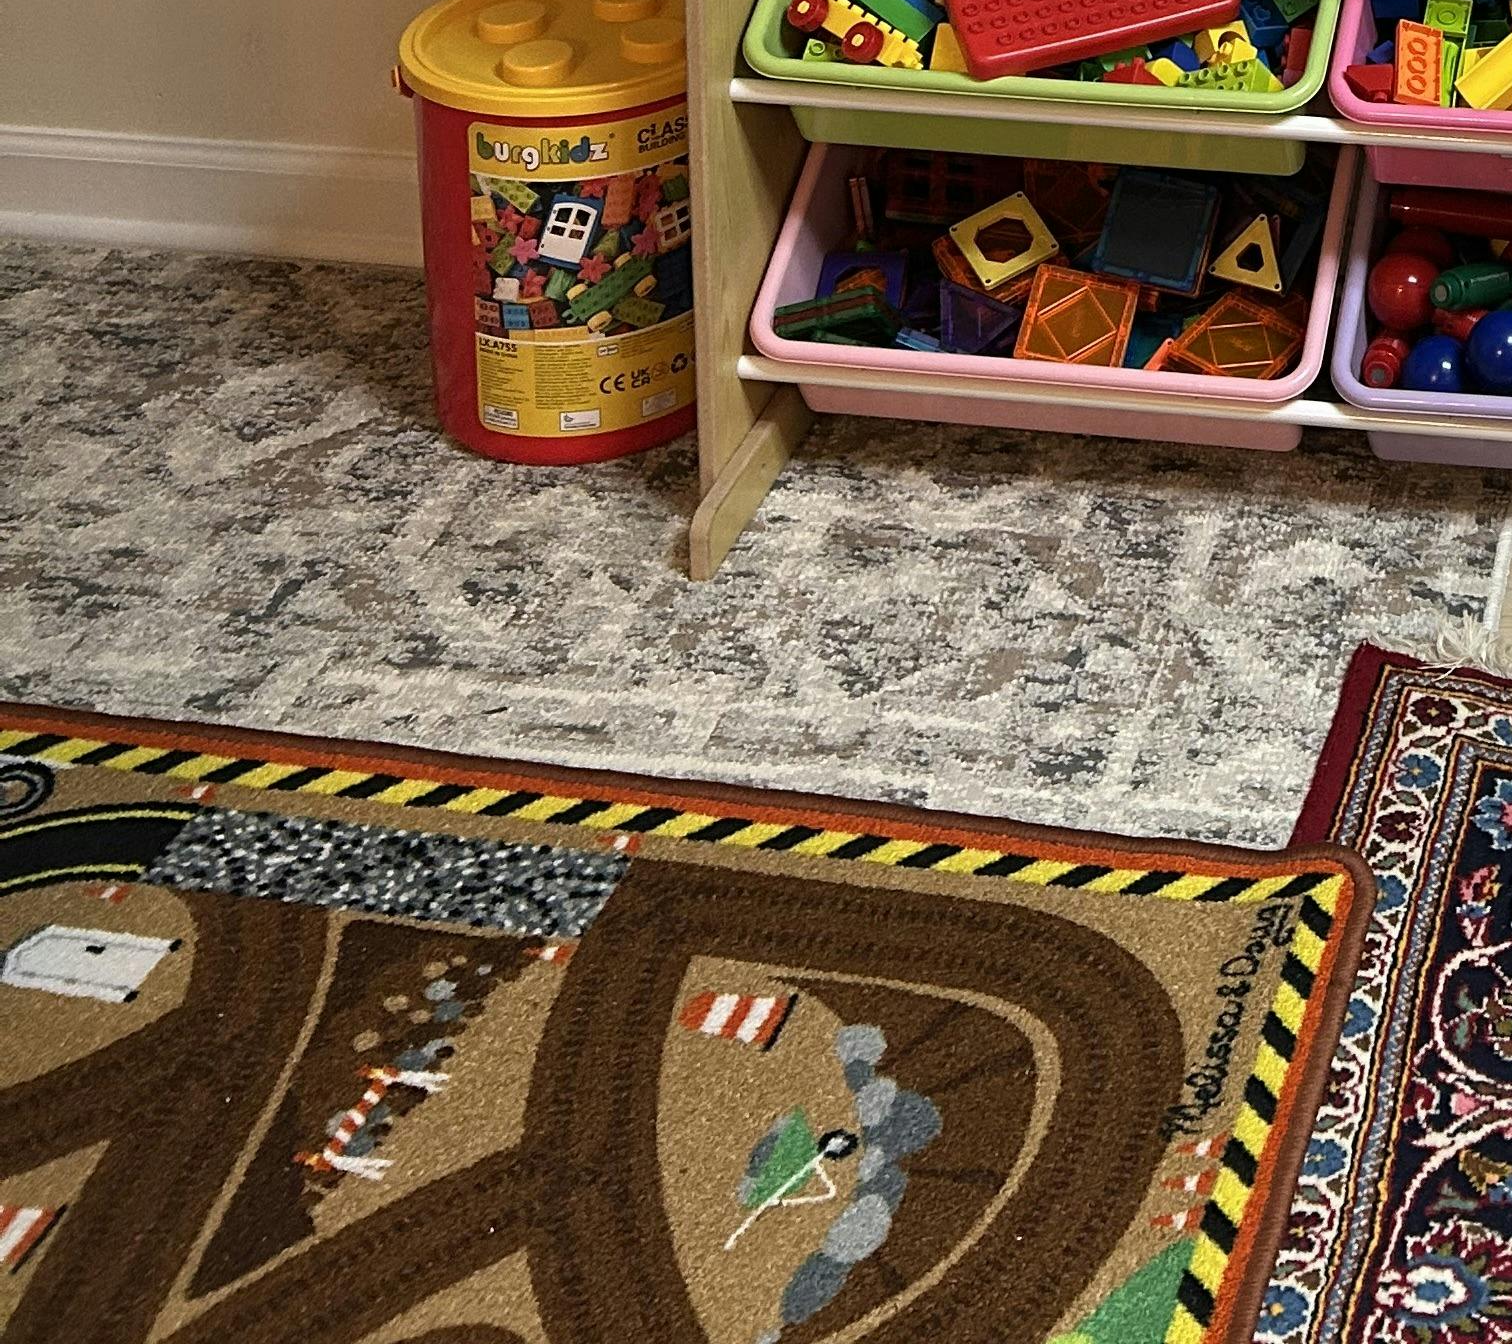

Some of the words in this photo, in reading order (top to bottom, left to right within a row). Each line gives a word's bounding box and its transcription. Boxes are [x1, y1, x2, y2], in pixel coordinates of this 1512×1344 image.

[476, 131, 609, 172] burgkidz
[1220, 902, 1294, 980] Doug
[1217, 976, 1252, 1002] &
[1158, 999, 1245, 1140] Melissa
